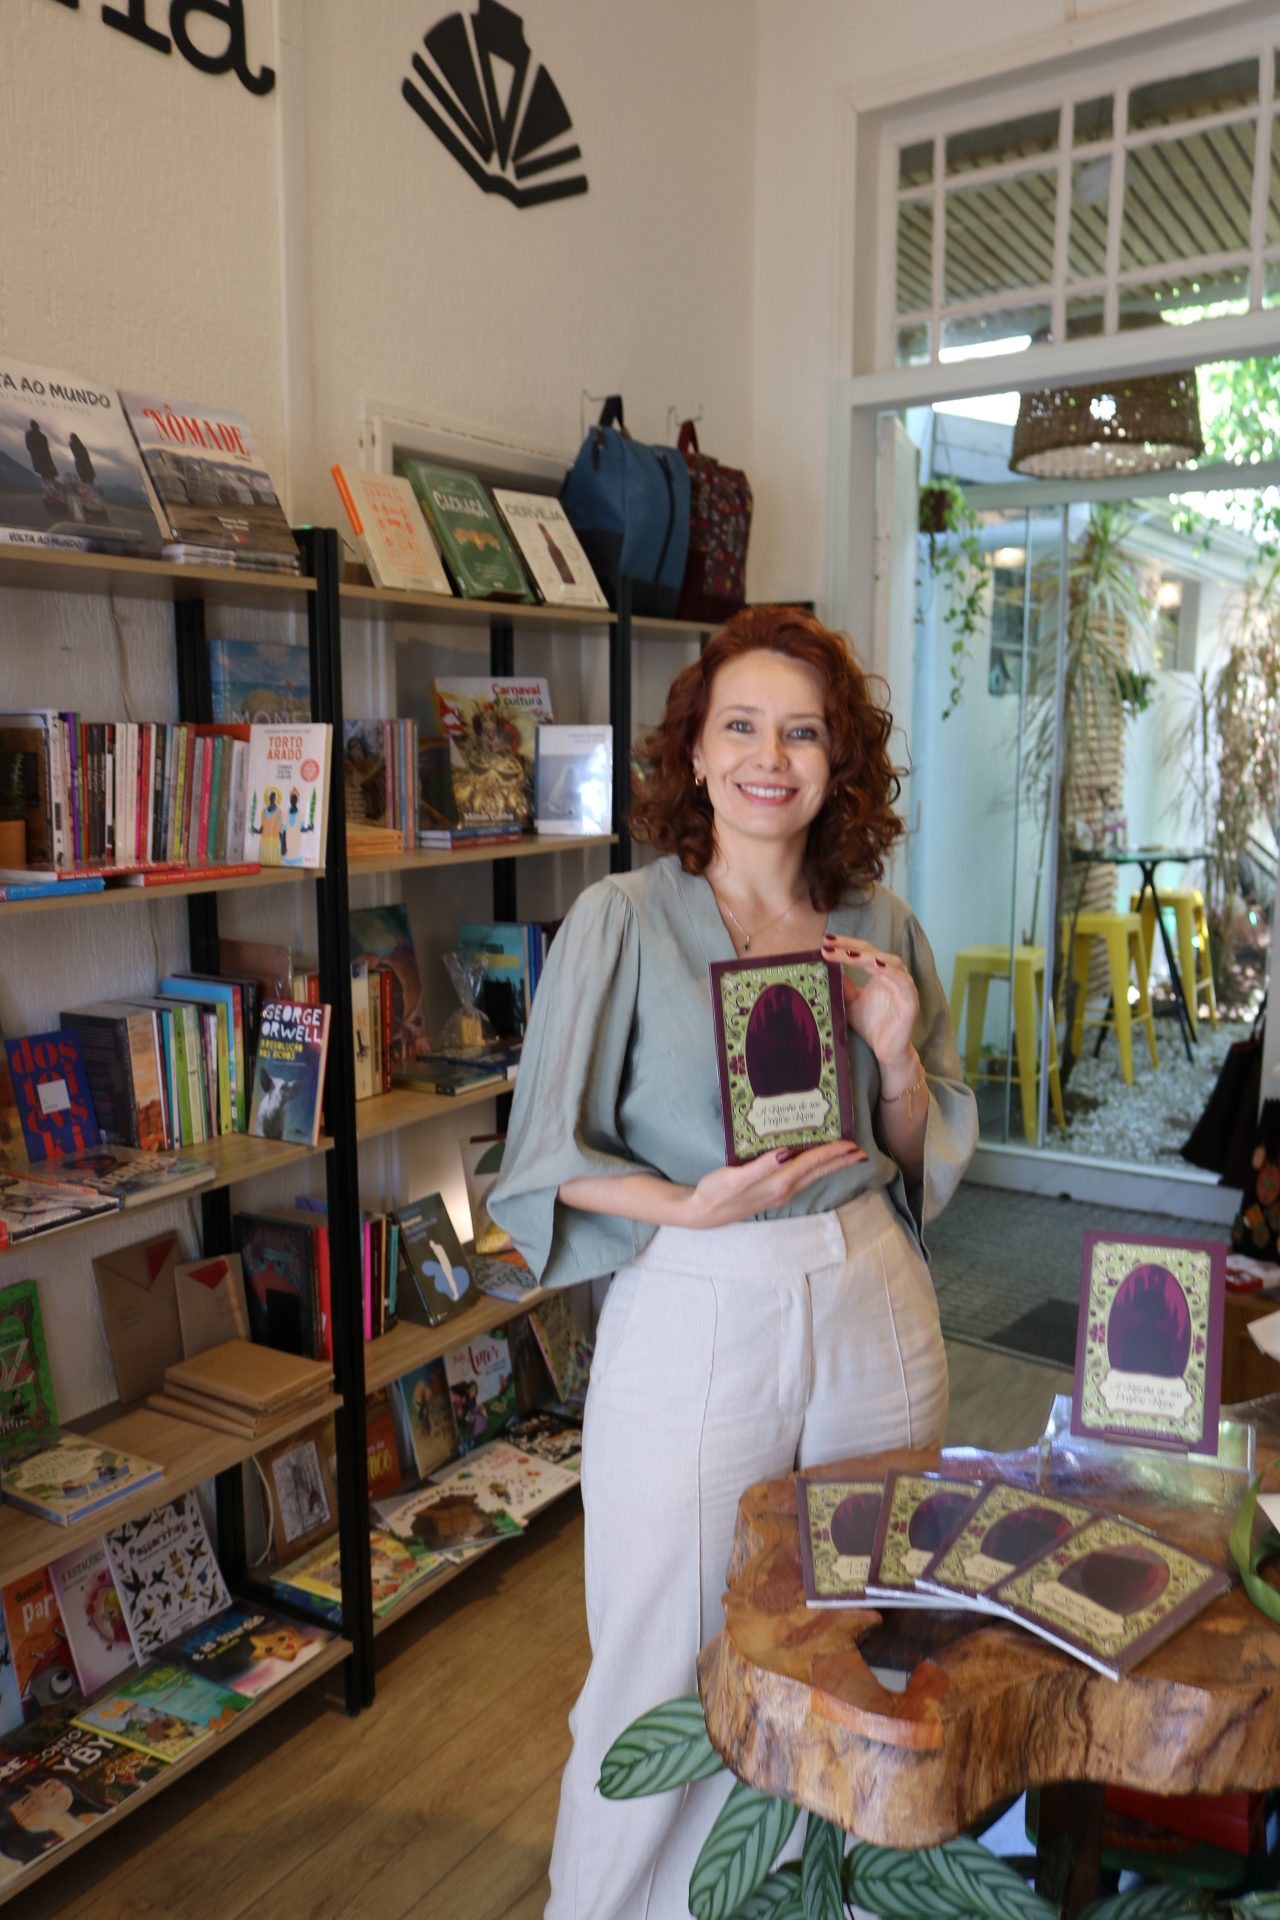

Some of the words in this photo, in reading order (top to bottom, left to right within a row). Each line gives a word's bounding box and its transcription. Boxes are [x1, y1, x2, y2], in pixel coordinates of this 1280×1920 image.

[21, 376, 45, 396] AO
[49, 383, 111, 409] MUNDO
[143, 401, 251, 457] NÔMADE
[505, 504, 566, 522] CERVEJA
[492, 683, 542, 697] Carnaval
[503, 694, 544, 706] cultura
[268, 735, 303, 749] TORTO
[267, 749, 302, 761] ARADO
[264, 1004, 323, 1026] GEORGE
[261, 1020, 322, 1043] ORWELL
[12, 1036, 78, 1075] dos
[128, 1520, 189, 1561] Passarinhos
[53, 1736, 115, 1774] YBY
